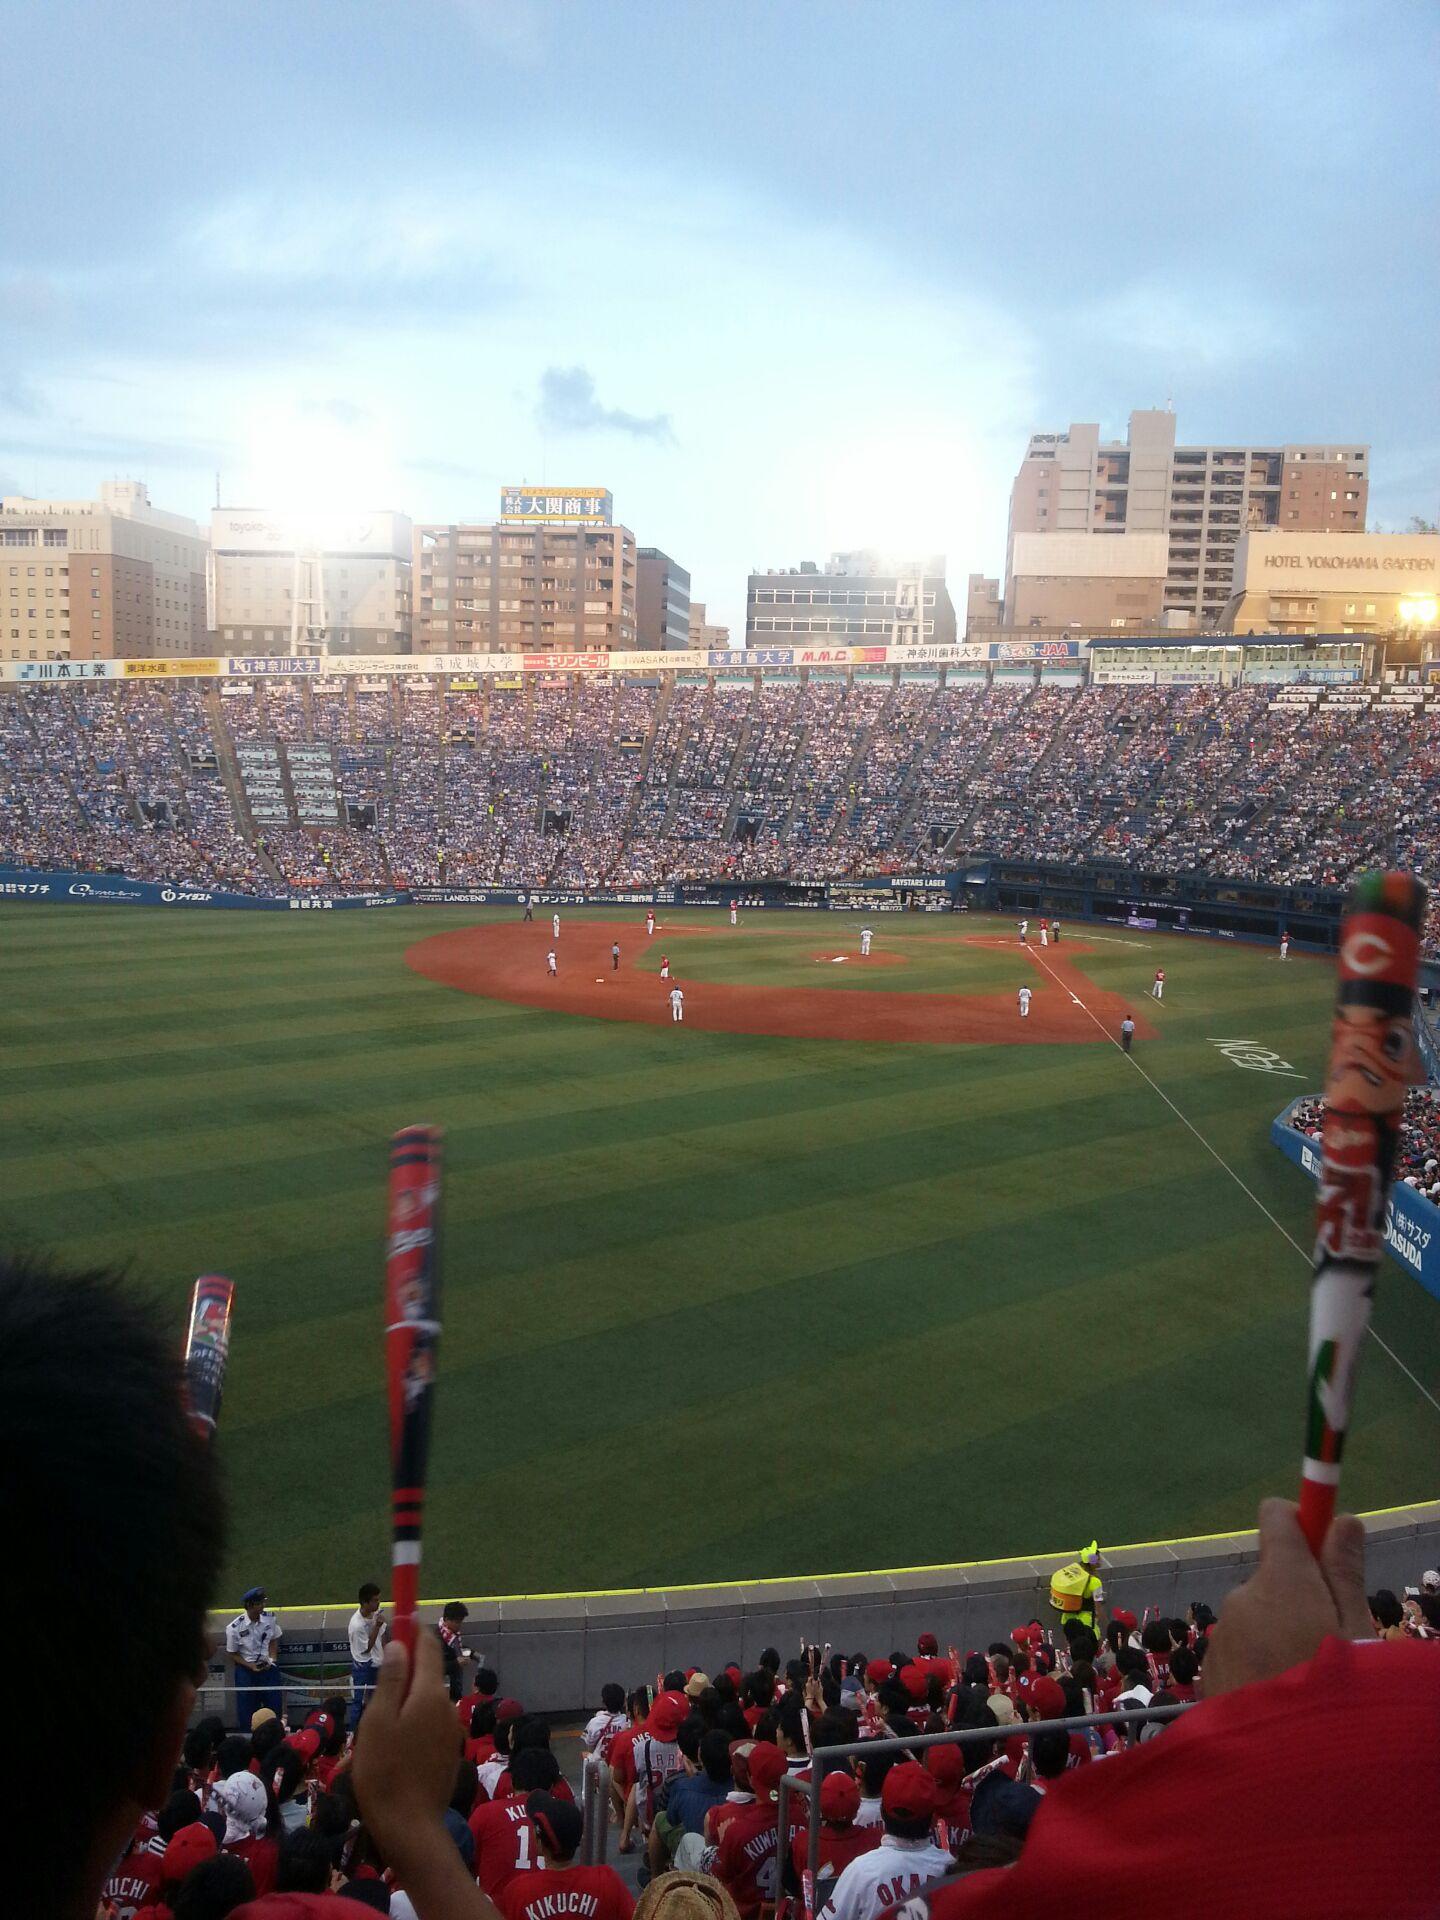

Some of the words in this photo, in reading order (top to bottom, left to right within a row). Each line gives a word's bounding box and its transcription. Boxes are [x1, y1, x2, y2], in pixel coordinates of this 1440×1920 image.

[526, 497, 600, 515] 大関商事
[1264, 556, 1302, 568] HOTEL
[1307, 556, 1379, 570] YOKOHAMA
[1383, 558, 1436, 571] GARDEN
[907, 647, 982, 659] 神奈川歯科大学
[1040, 643, 1069, 657] JAA
[450, 656, 513, 670] 成城大学
[545, 655, 608, 668] キリンビール
[730, 651, 791, 664] 創価大学
[39, 664, 106, 677] 川本工業
[254, 660, 316, 672] 神奈川大学
[891, 878, 924, 887] BAYSTARS
[514, 1825, 546, 1870] 1
[524, 1892, 598, 1920] KIKUCHI
